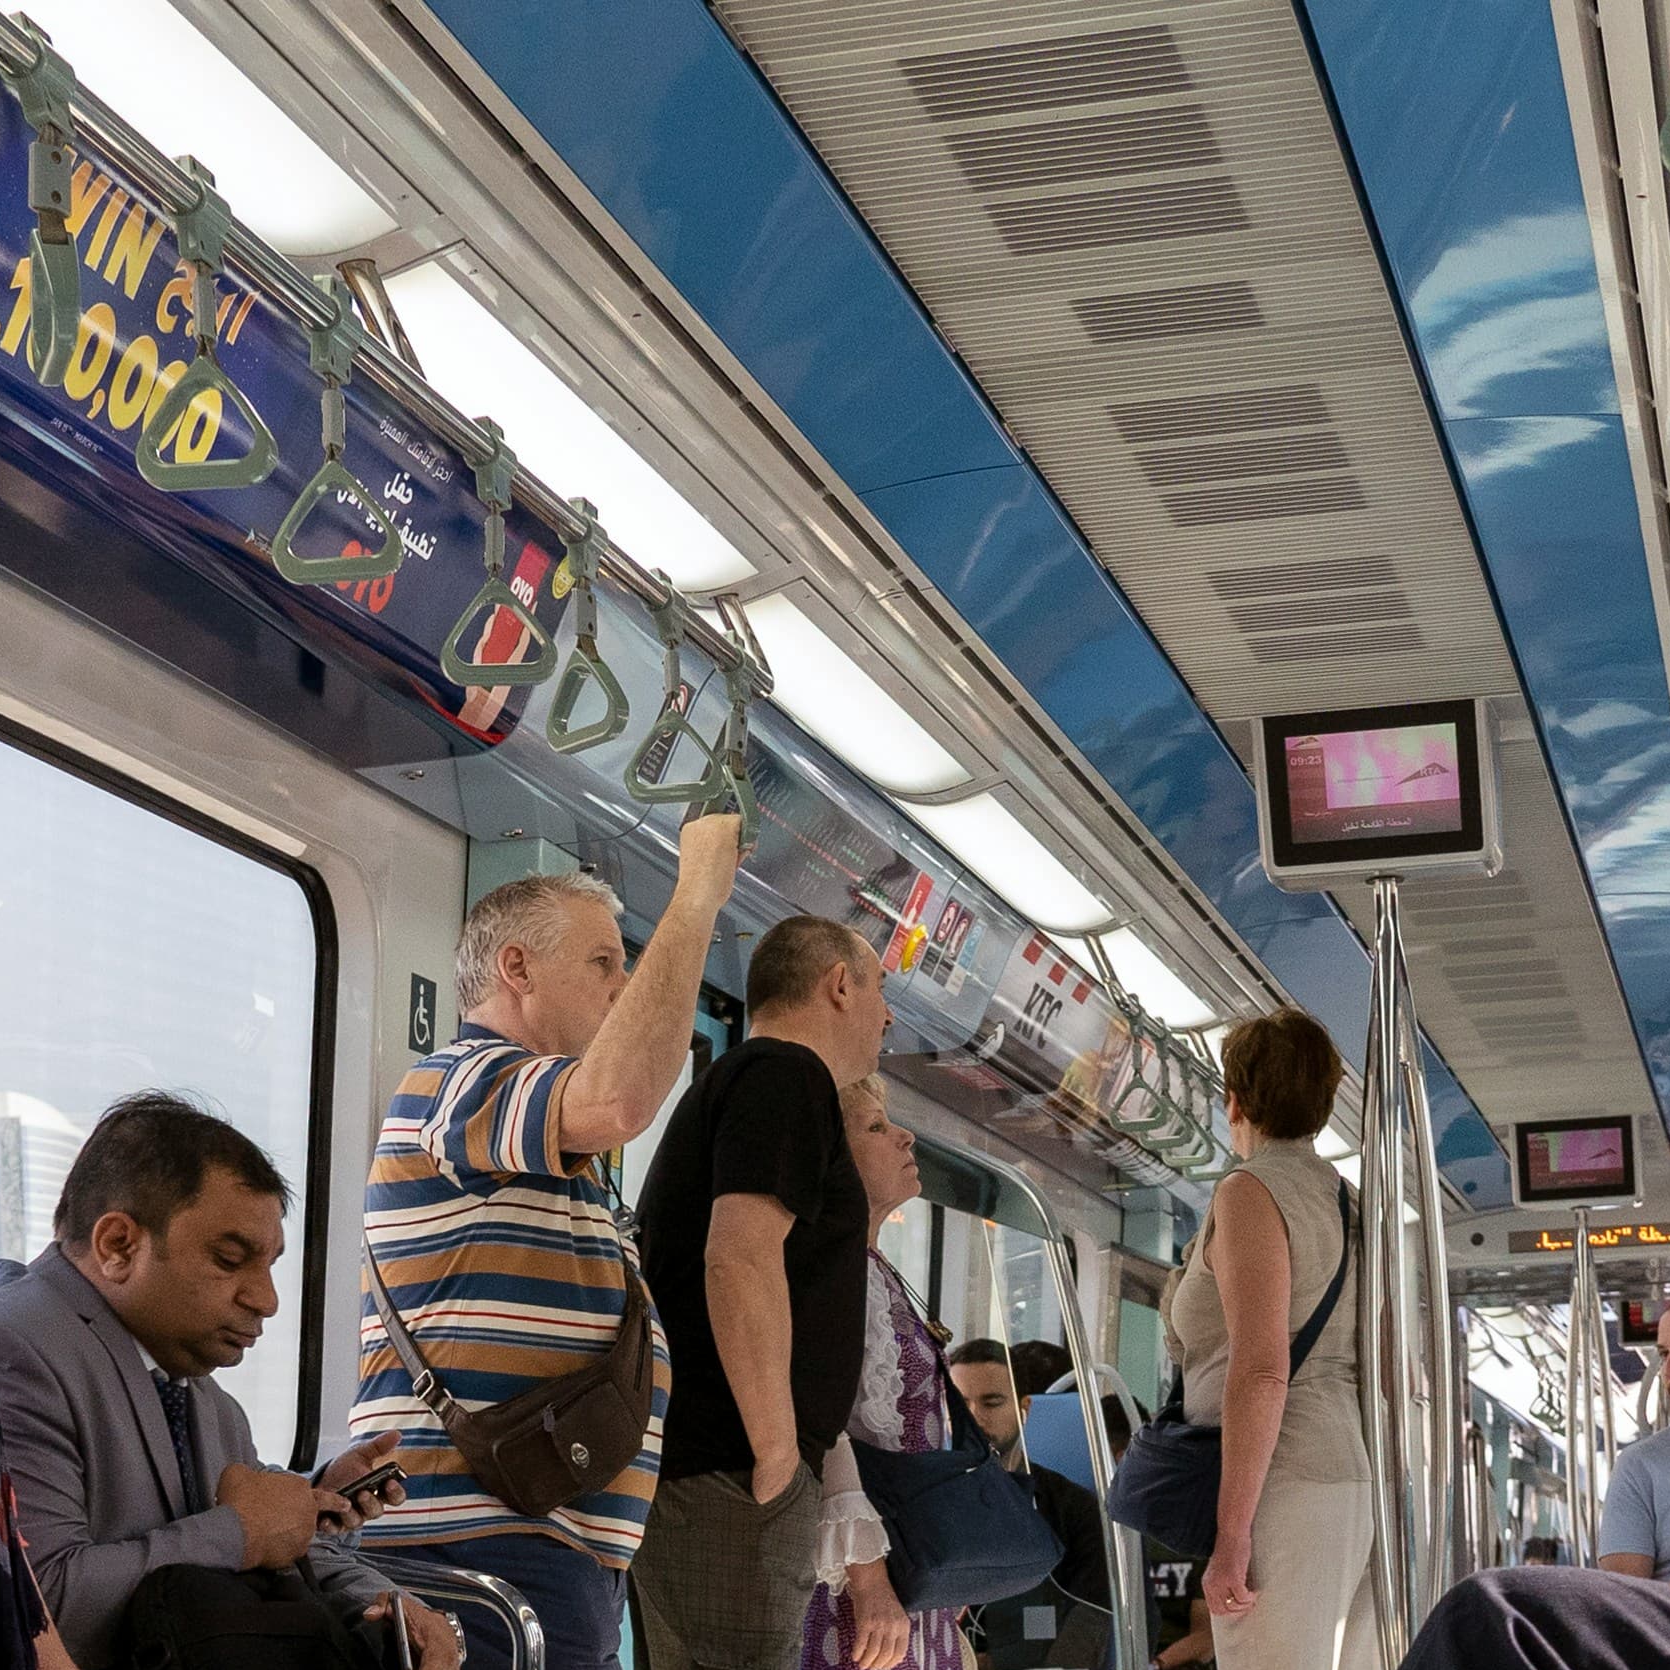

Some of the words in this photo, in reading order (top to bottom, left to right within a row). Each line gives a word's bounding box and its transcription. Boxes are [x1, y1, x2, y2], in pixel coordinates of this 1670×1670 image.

[0, 256, 223, 464] 10,000
[510, 575, 535, 607] OYO
[1290, 755, 1323, 766] 09:23
[1419, 766, 1442, 777] RTA
[1013, 981, 1064, 1050] KFC
